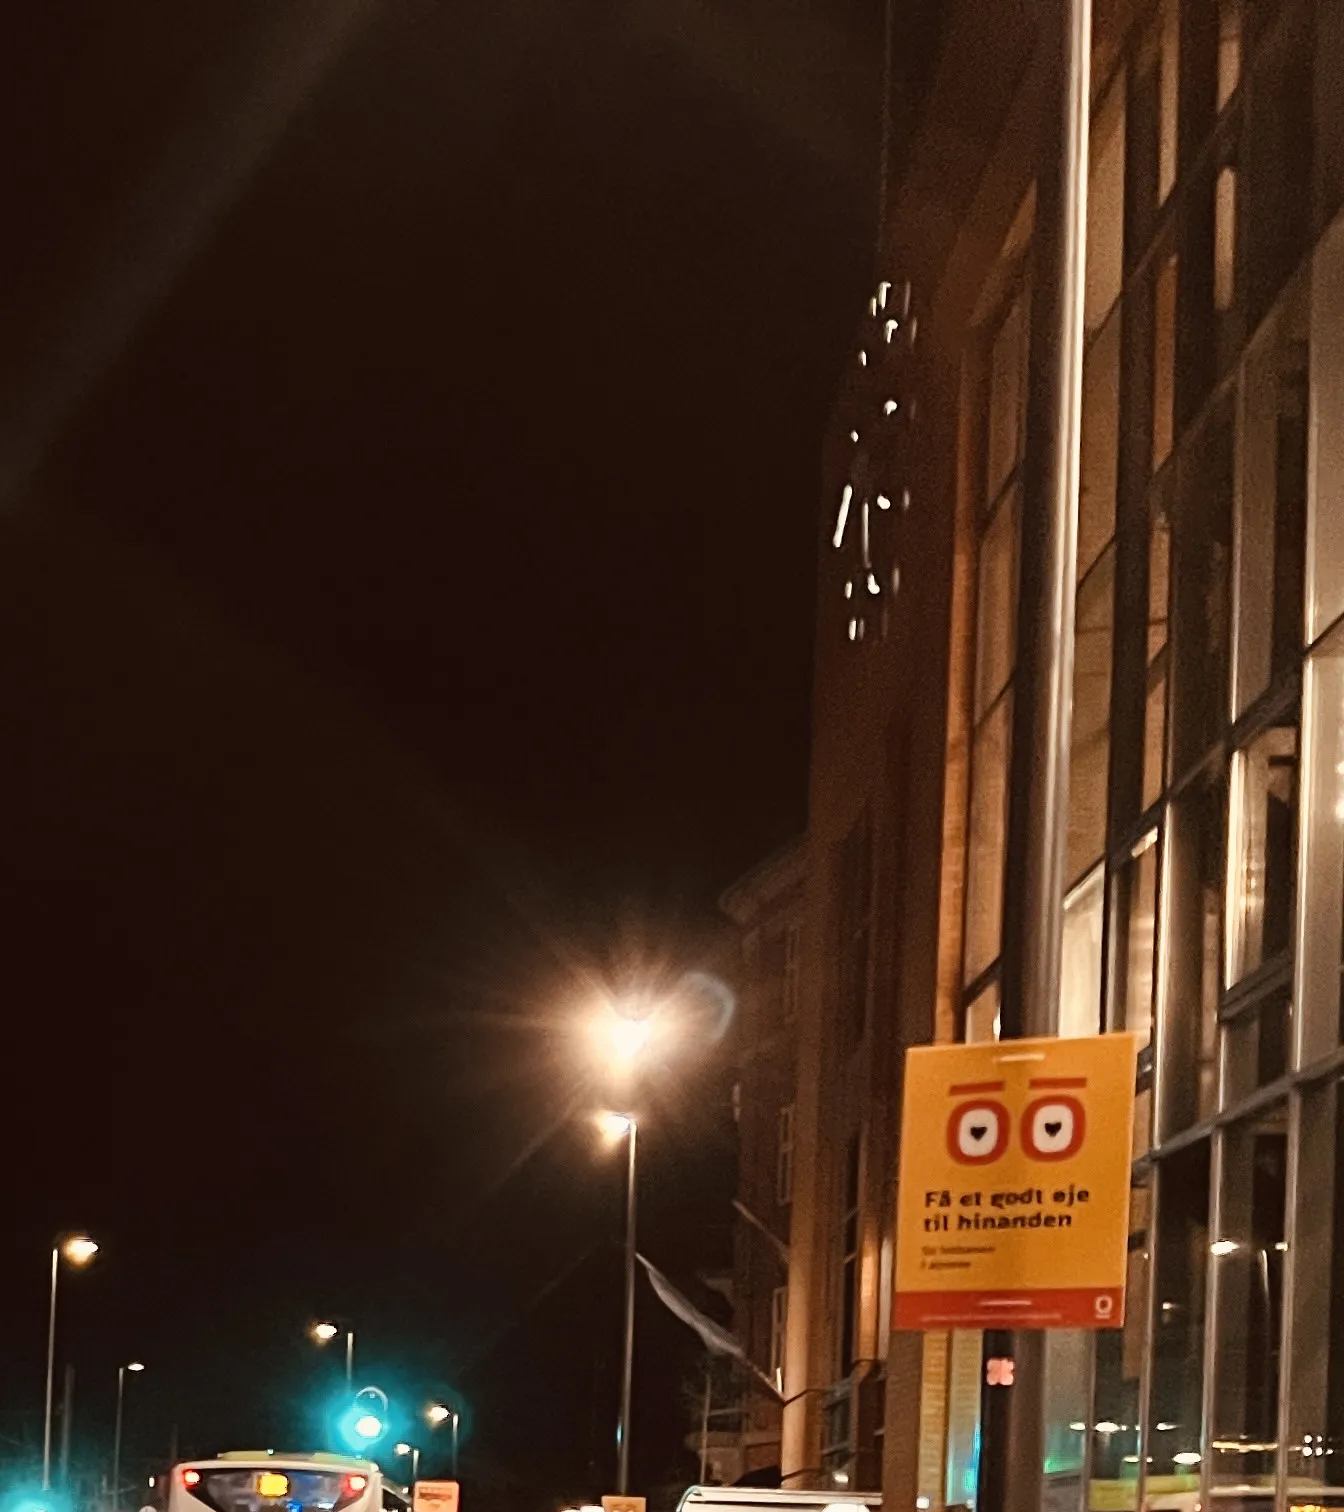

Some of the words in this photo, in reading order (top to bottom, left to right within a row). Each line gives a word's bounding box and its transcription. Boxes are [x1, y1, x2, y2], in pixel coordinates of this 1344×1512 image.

[924, 1189, 952, 1208] Få
[959, 1191, 982, 1207] et
[990, 1187, 1043, 1210] godt
[924, 1213, 949, 1232] til
[957, 1211, 1073, 1231] hinanden
